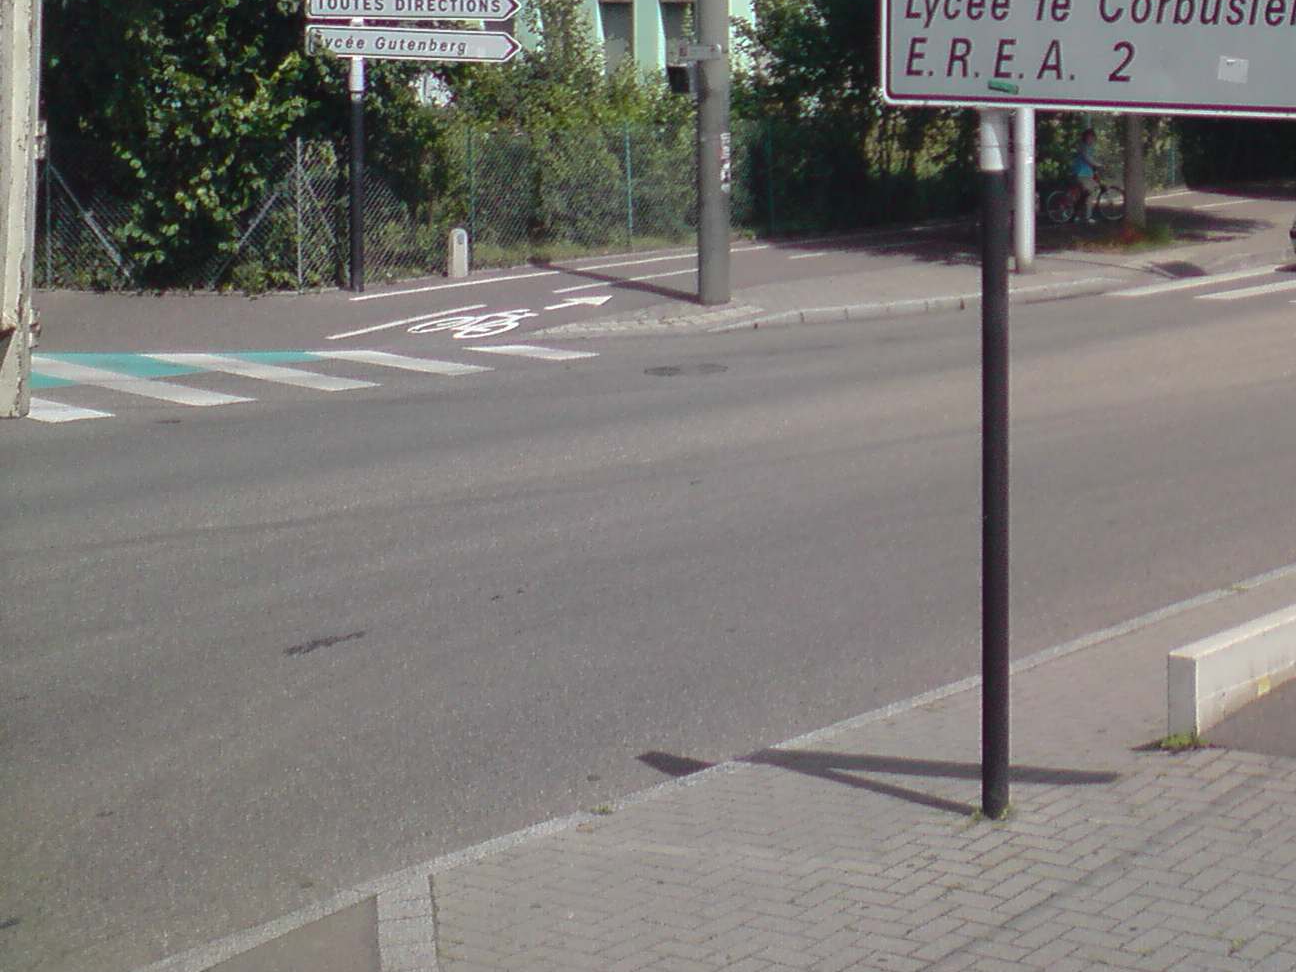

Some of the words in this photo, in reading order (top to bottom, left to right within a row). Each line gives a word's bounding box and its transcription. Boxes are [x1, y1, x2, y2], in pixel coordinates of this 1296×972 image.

[317, 34, 365, 50] ycée
[375, 36, 467, 55] Gutenberg
[1108, 41, 1135, 82] 2
